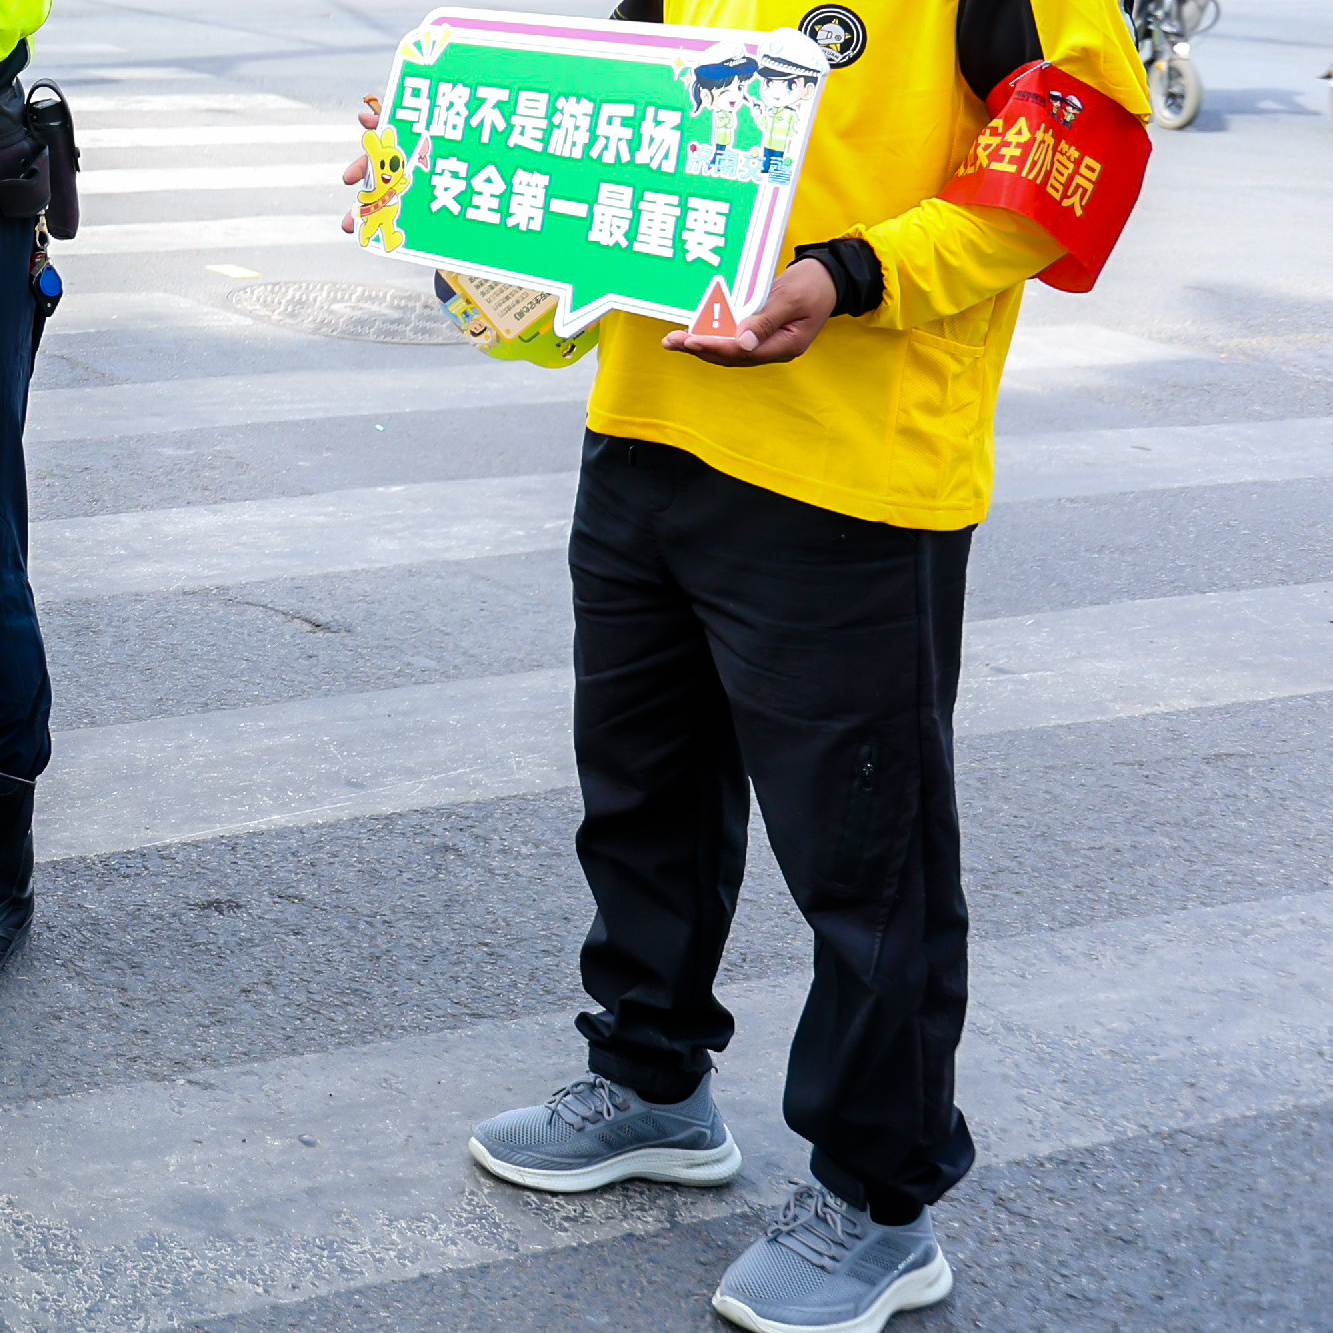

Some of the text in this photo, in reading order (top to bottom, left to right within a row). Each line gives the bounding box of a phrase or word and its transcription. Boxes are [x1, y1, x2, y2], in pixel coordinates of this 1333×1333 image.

[395, 76, 683, 174] 马路不是游乐场
[429, 157, 730, 267] 安全第一最重要
